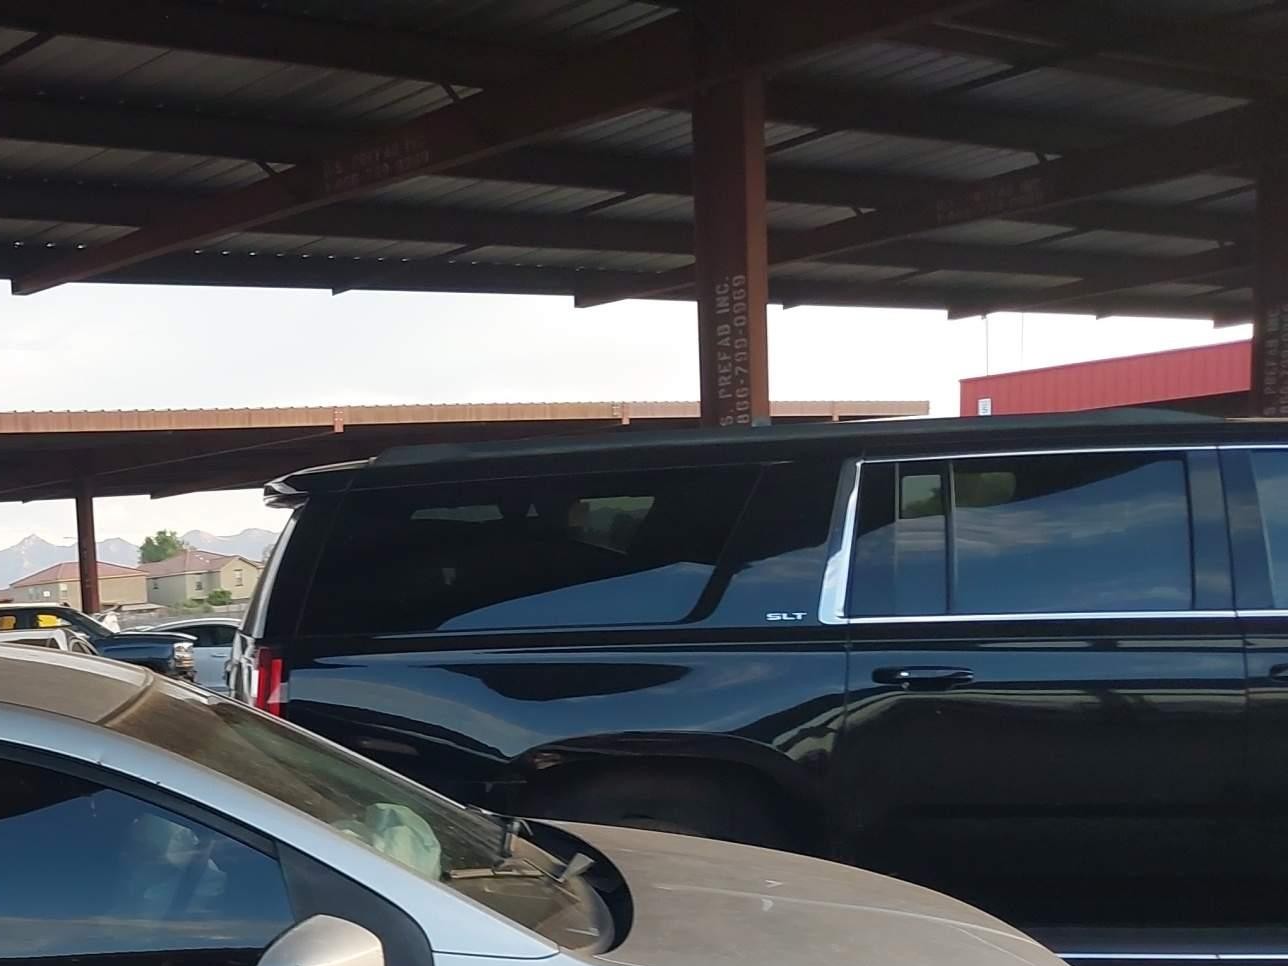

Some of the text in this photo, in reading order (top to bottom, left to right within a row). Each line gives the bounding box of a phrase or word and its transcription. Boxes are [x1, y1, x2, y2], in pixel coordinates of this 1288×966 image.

[715, 276, 730, 315] INC.
[717, 324, 732, 399] PREFAB
[766, 612, 808, 621] SLT
